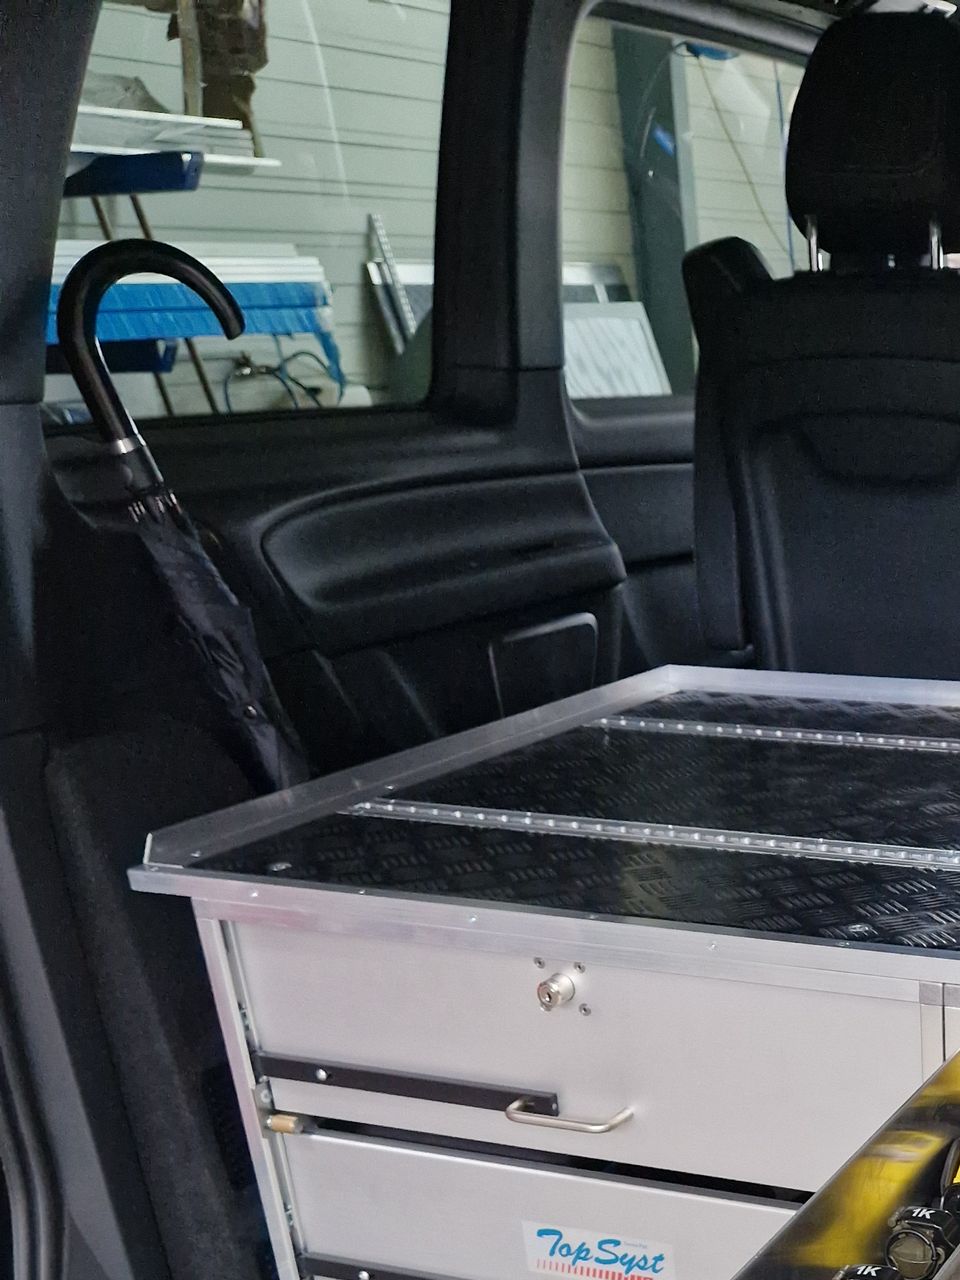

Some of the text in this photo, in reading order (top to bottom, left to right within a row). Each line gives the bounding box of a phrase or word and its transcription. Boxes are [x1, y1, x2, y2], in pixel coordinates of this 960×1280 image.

[911, 1207, 936, 1219] 1K
[536, 1228, 665, 1275] TopSyst
[856, 1265, 881, 1277] 1K
